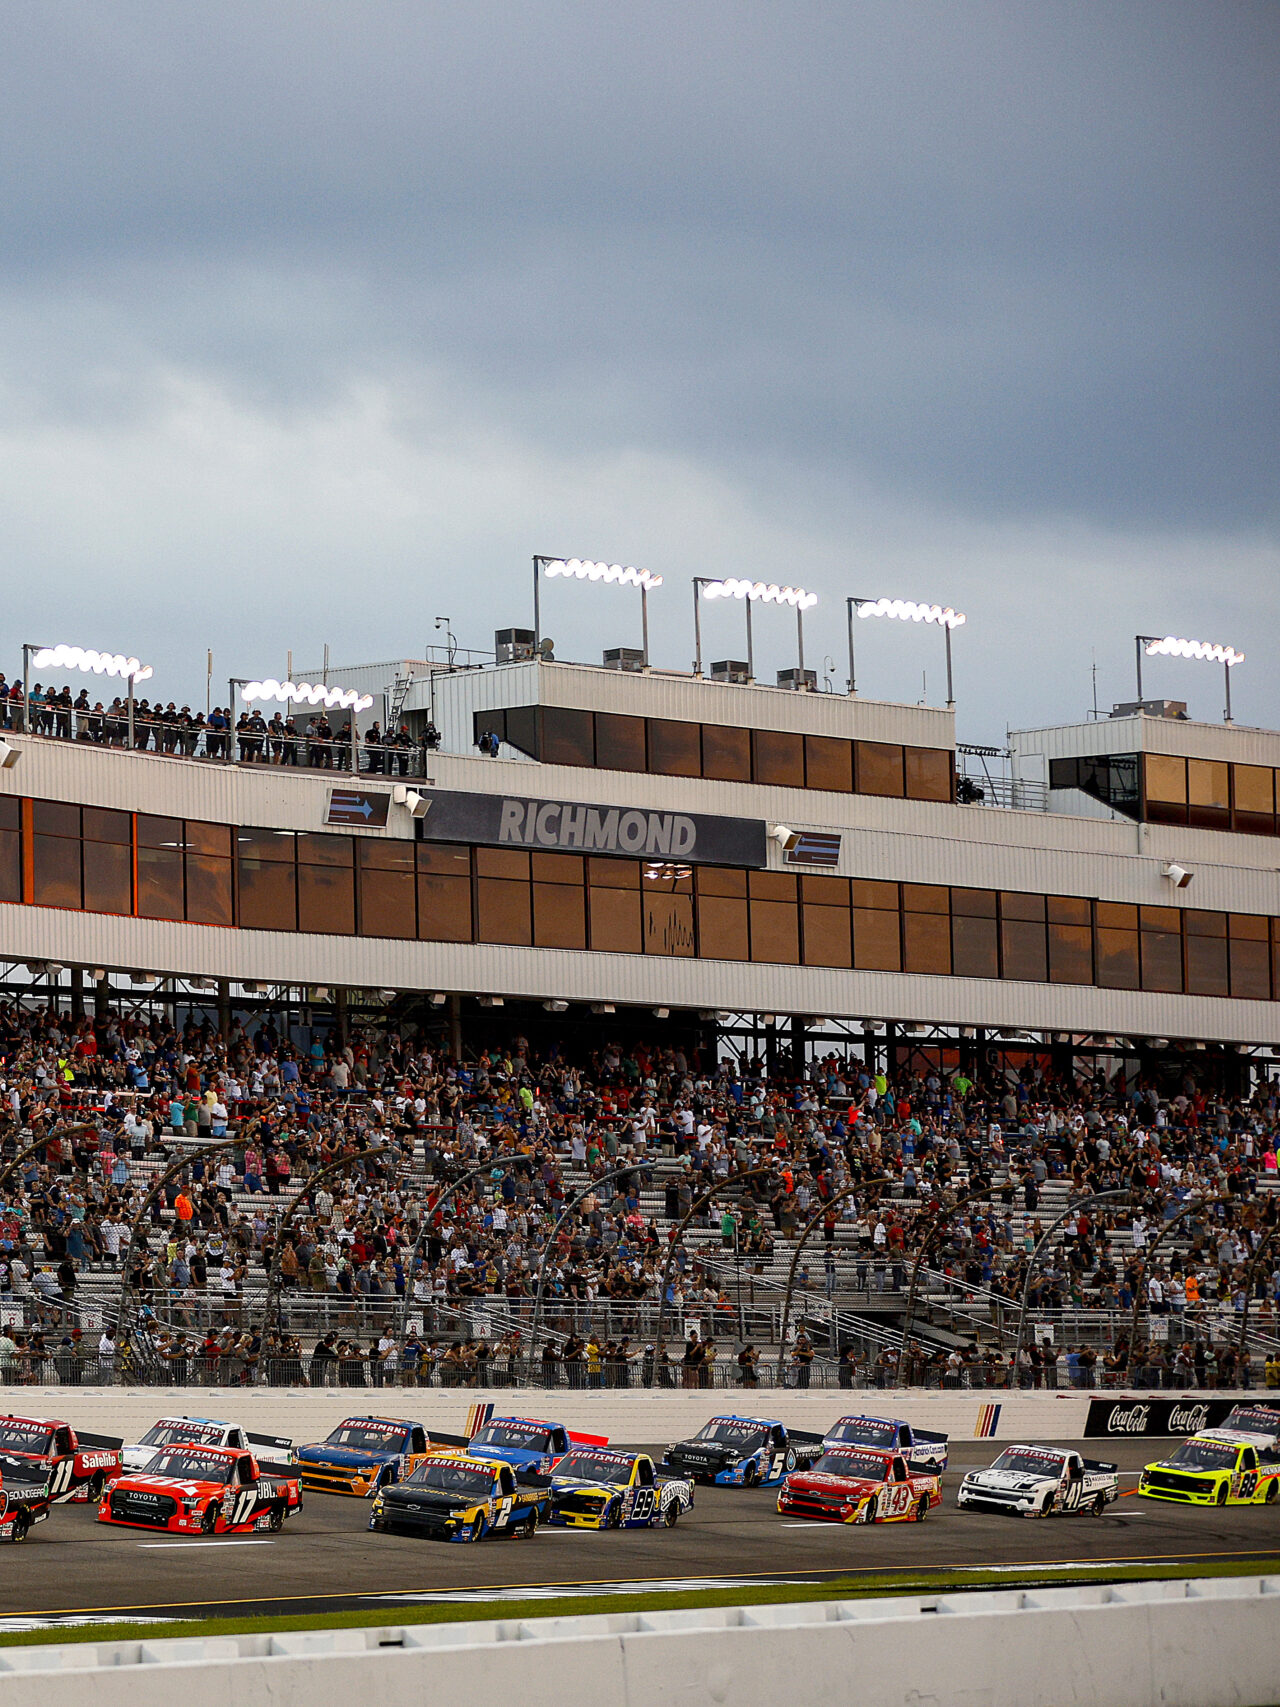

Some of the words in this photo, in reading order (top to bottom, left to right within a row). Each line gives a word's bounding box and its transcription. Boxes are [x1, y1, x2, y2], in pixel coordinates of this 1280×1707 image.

[499, 800, 696, 856] RICHMOND
[159, 1420, 220, 1436] CRAFTSMAN
[343, 1420, 402, 1435] CRAFTSMAN
[488, 1420, 543, 1434] CRAFTSMAN
[711, 1418, 764, 1432] CRAFTSMAN
[840, 1418, 891, 1431] CRAFTSMAN
[1185, 1440, 1235, 1453] CRAFTSMAN
[81, 1453, 116, 1469] Safelite
[162, 1447, 229, 1462] CRAFTSMAN
[570, 1450, 629, 1465] CRAFTSMAN
[684, 1454, 708, 1463] TOYOTA
[828, 1449, 884, 1463] CRAFTSMAN
[1008, 1448, 1061, 1461] CRAFTSMAN
[426, 1458, 491, 1474] CRAFTSMAN
[768, 1452, 786, 1480] 5
[51, 1460, 74, 1494] 11
[1238, 1473, 1259, 1498] 88
[9, 1489, 45, 1501] SOUNDGEAR
[128, 1492, 158, 1502] TOYOTA
[891, 1486, 911, 1513] 43
[1065, 1481, 1082, 1509] 41
[232, 1490, 258, 1524] 17
[495, 1496, 513, 1527] 2
[631, 1489, 655, 1520] 99
